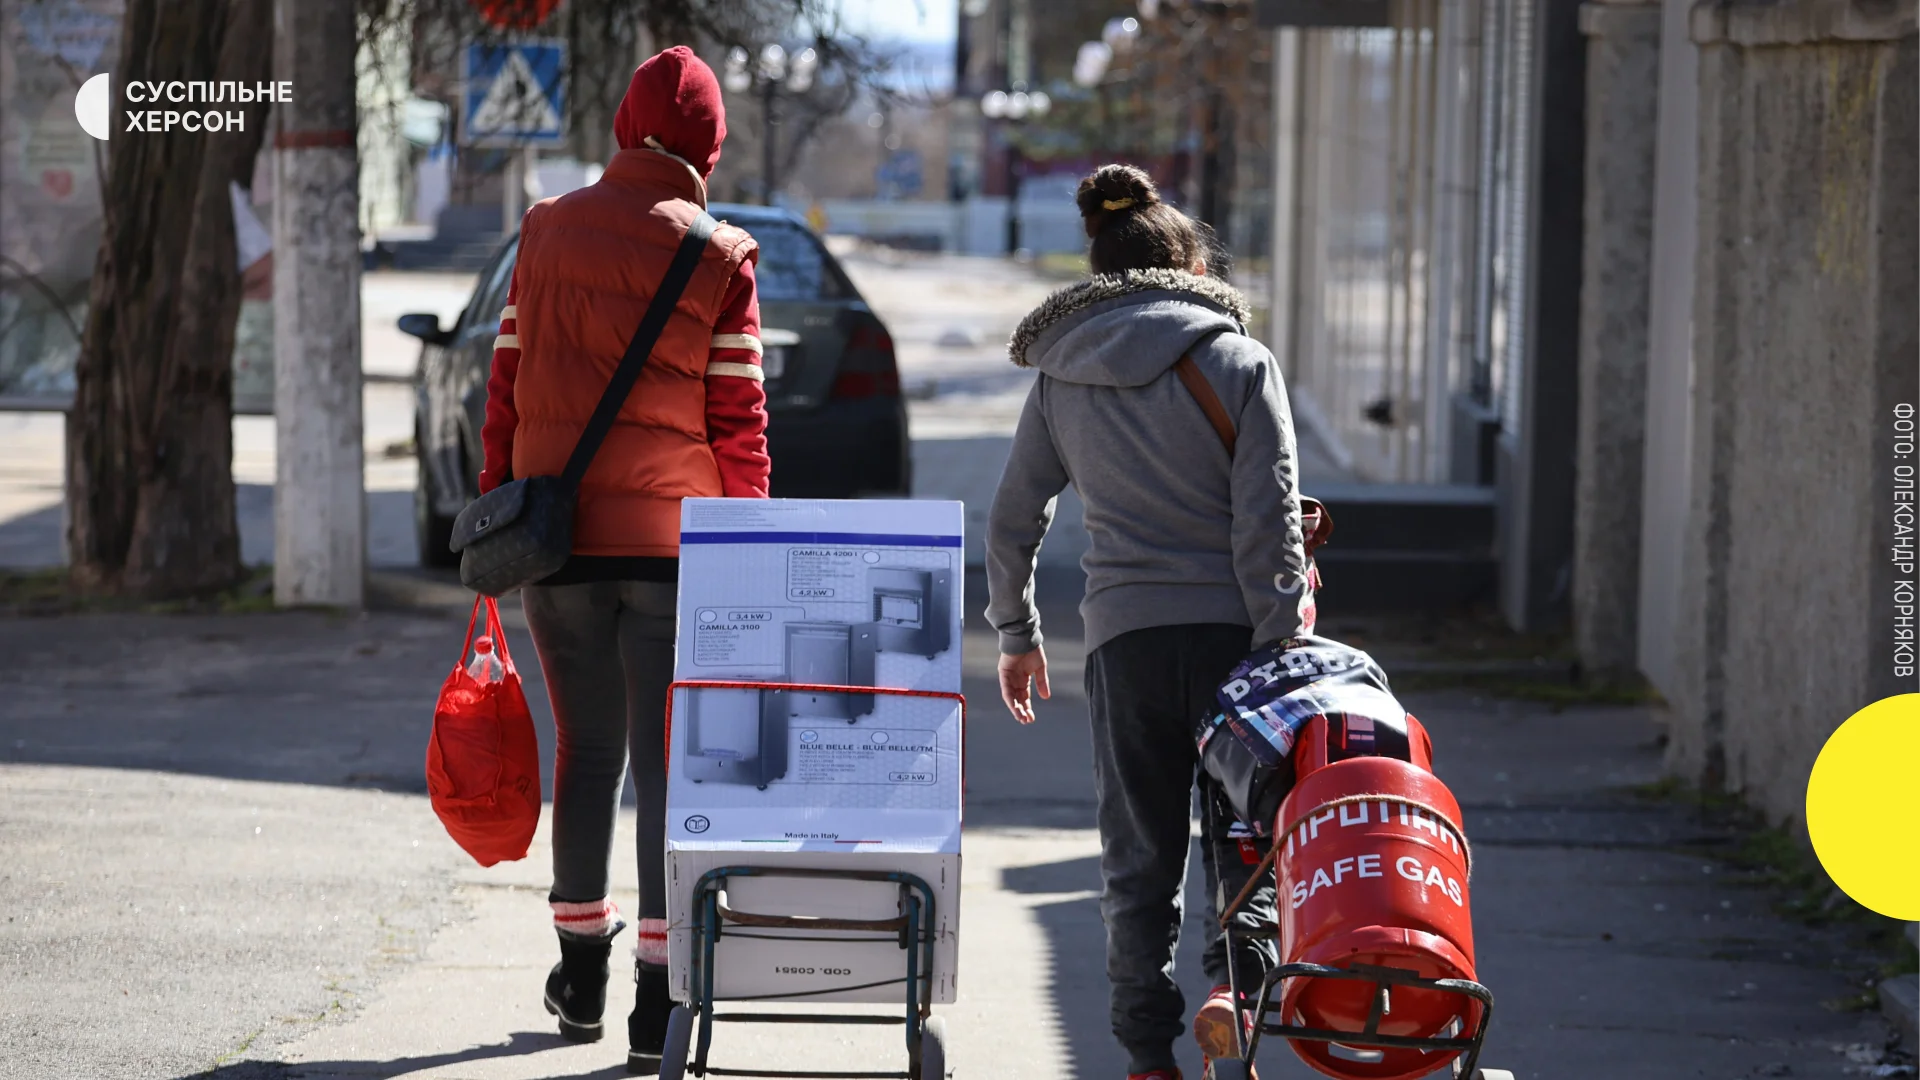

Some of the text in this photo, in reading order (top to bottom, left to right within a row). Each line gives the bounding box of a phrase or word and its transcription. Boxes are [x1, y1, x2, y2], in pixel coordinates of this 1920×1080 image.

[1292, 854, 1463, 910] SAFE GAS
[819, 967, 851, 976] COD.
